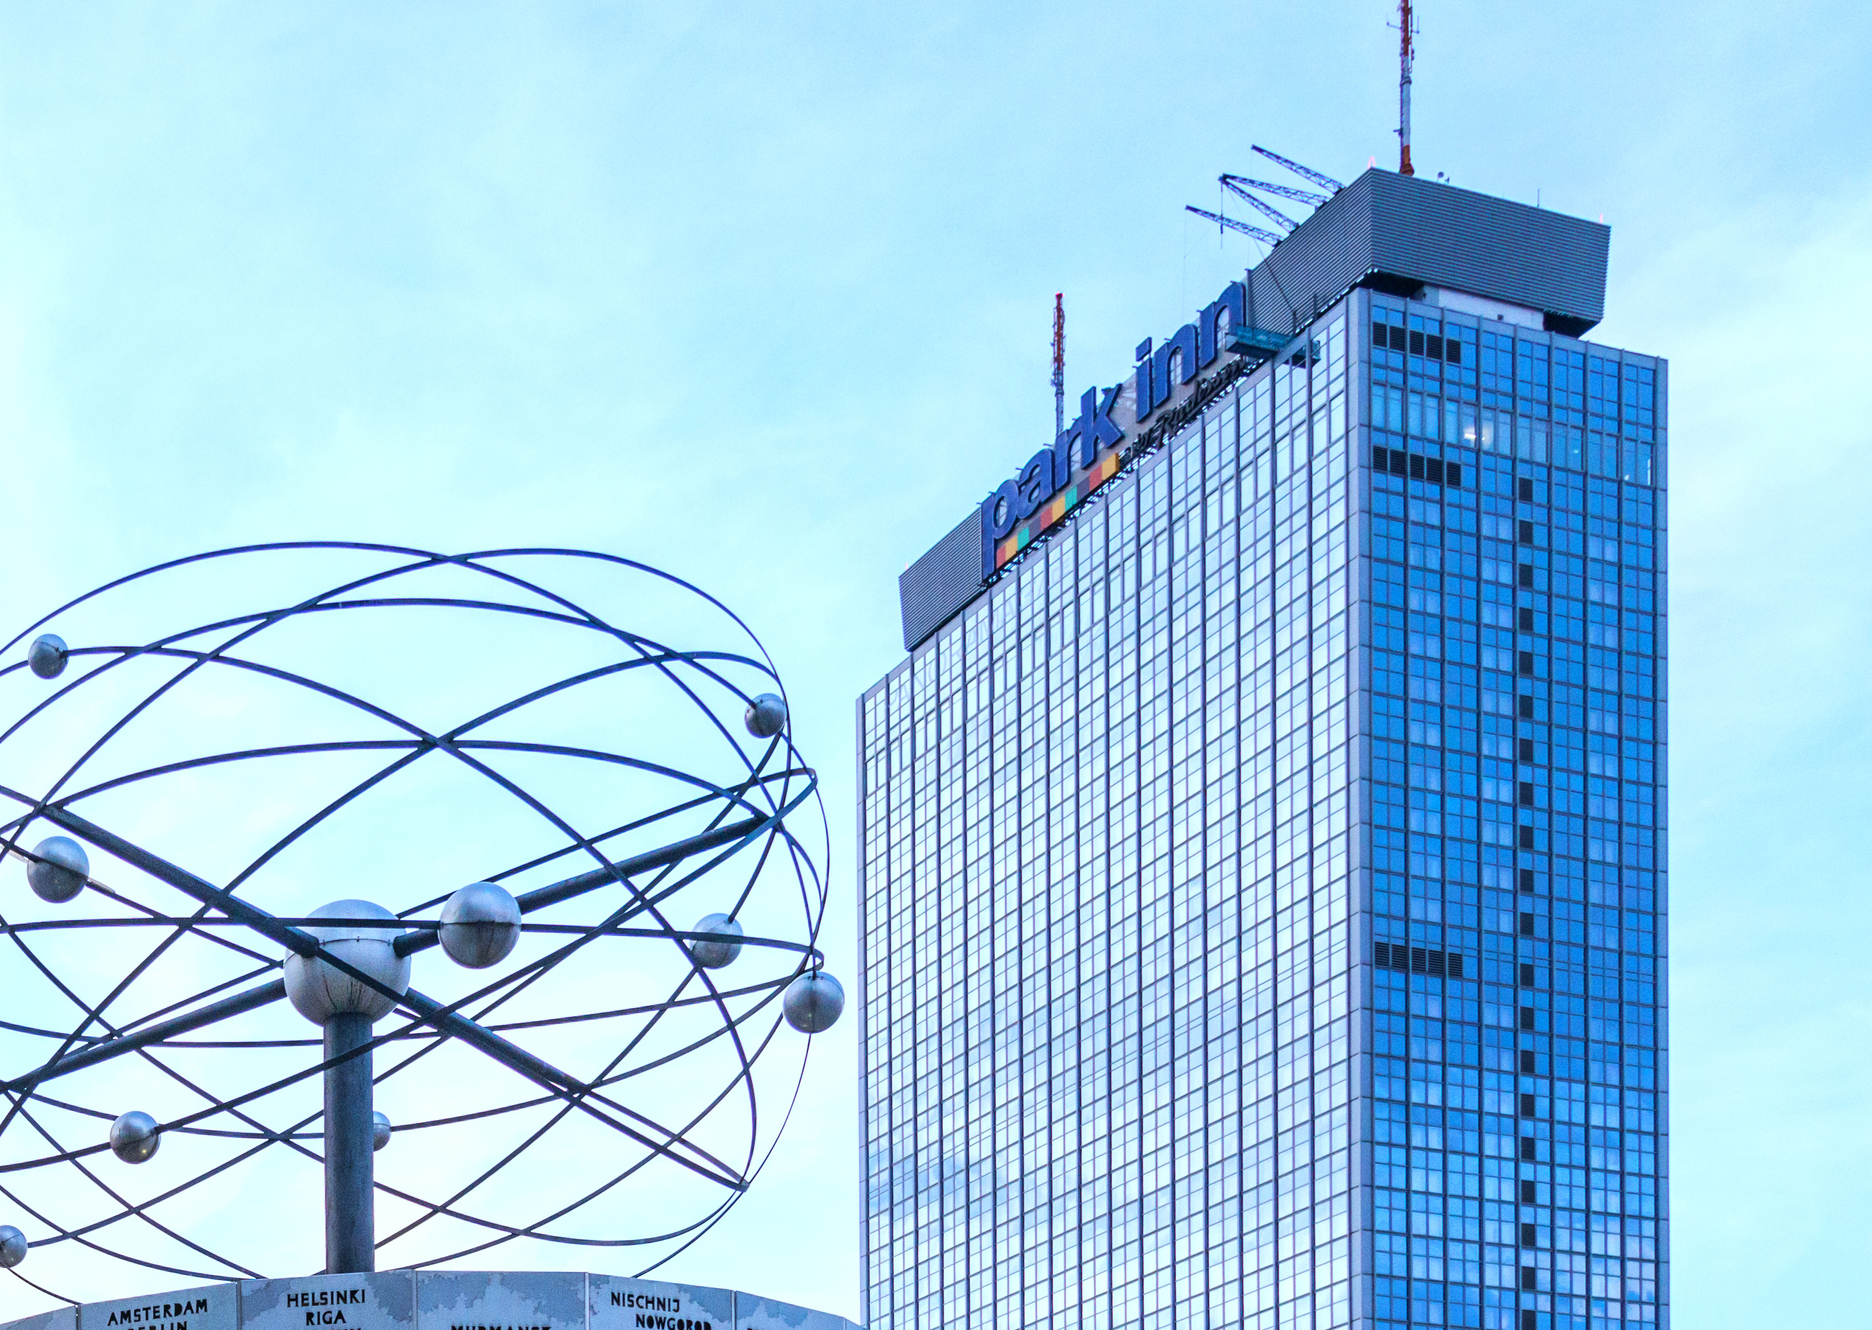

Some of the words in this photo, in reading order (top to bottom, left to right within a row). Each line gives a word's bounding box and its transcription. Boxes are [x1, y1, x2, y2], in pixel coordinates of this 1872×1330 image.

[981, 385, 1125, 583] park
[1135, 281, 1247, 424] inn
[286, 1289, 366, 1308] HELSINKI
[610, 1292, 680, 1312] NISCHNIJ
[107, 1298, 208, 1326] AMSTERDAM
[306, 1310, 346, 1326] RIGA
